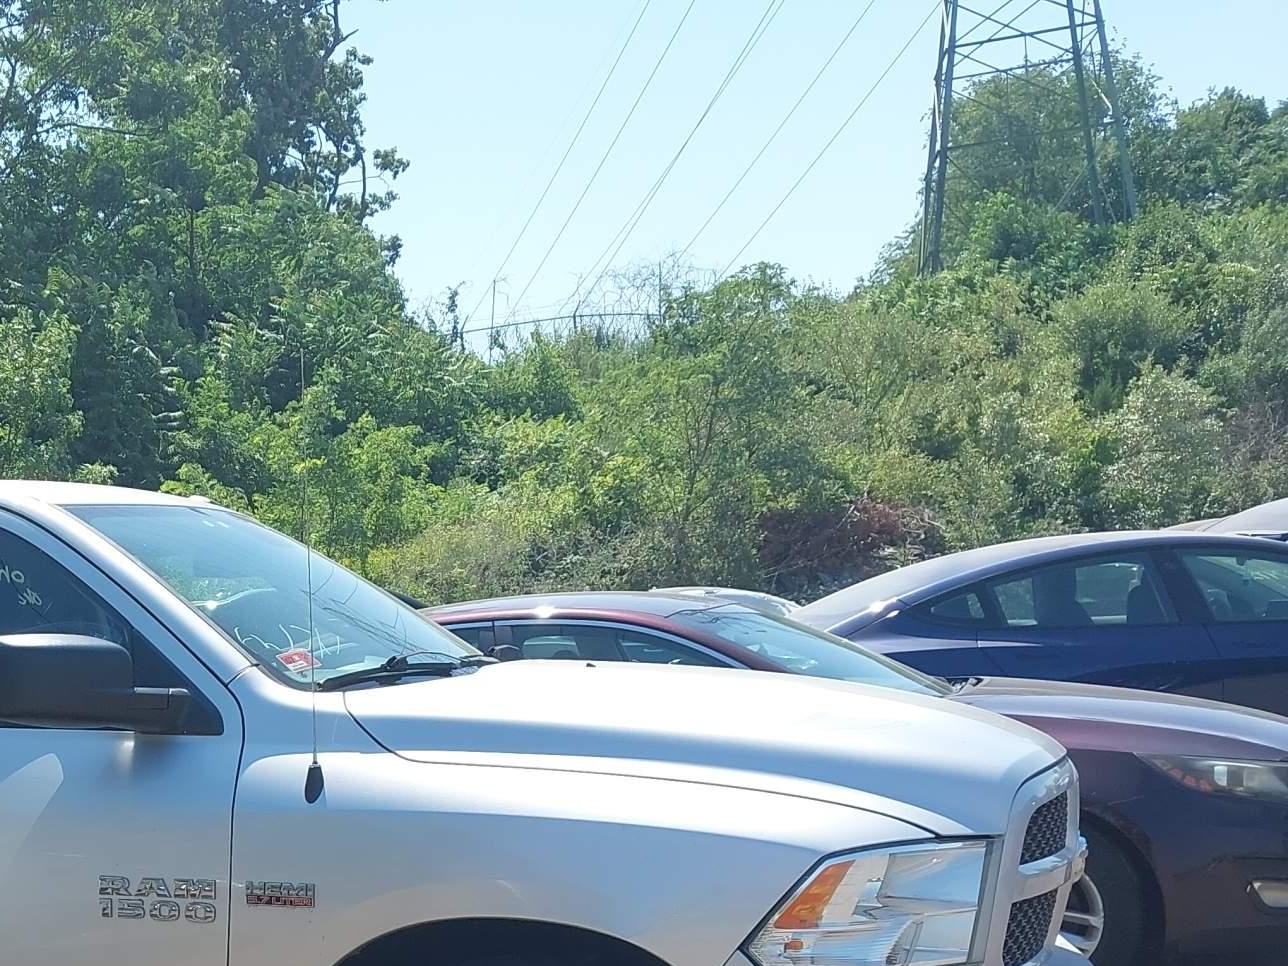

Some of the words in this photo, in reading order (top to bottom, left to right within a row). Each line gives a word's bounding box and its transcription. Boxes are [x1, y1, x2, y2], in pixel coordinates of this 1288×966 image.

[99, 875, 216, 900] RAM
[246, 881, 315, 896] HEMI
[99, 898, 216, 924] 1500
